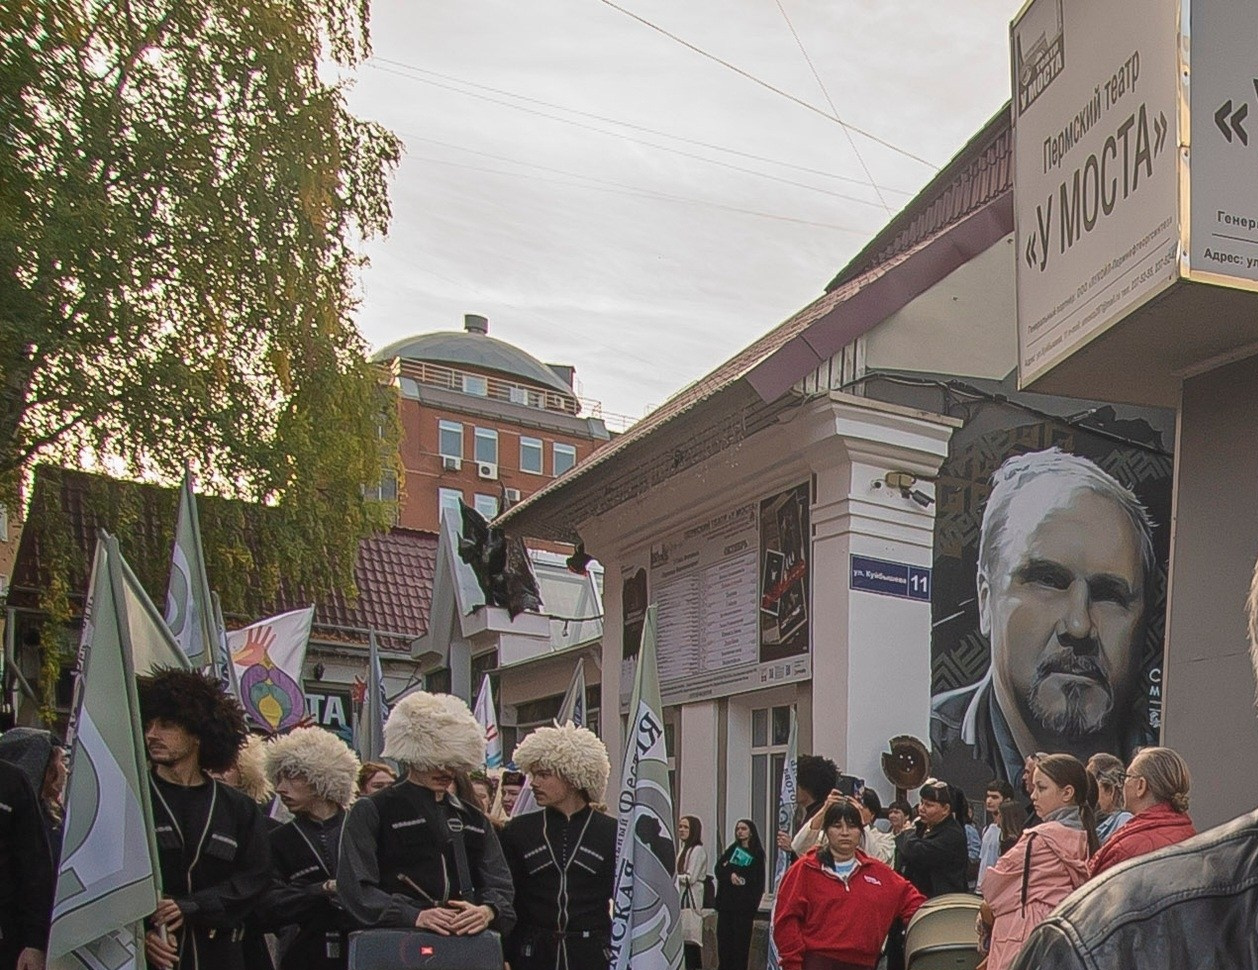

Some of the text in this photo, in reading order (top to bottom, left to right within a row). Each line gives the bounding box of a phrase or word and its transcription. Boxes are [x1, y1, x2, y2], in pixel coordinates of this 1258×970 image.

[1030, 51, 1064, 102] МОСТА
[1043, 51, 1140, 174] Пермский театр
[1026, 103, 1167, 272] «У МОСТА»
[1203, 248, 1243, 265] Адрес:
[910, 575, 928, 592] 11
[304, 693, 347, 727] ТА
